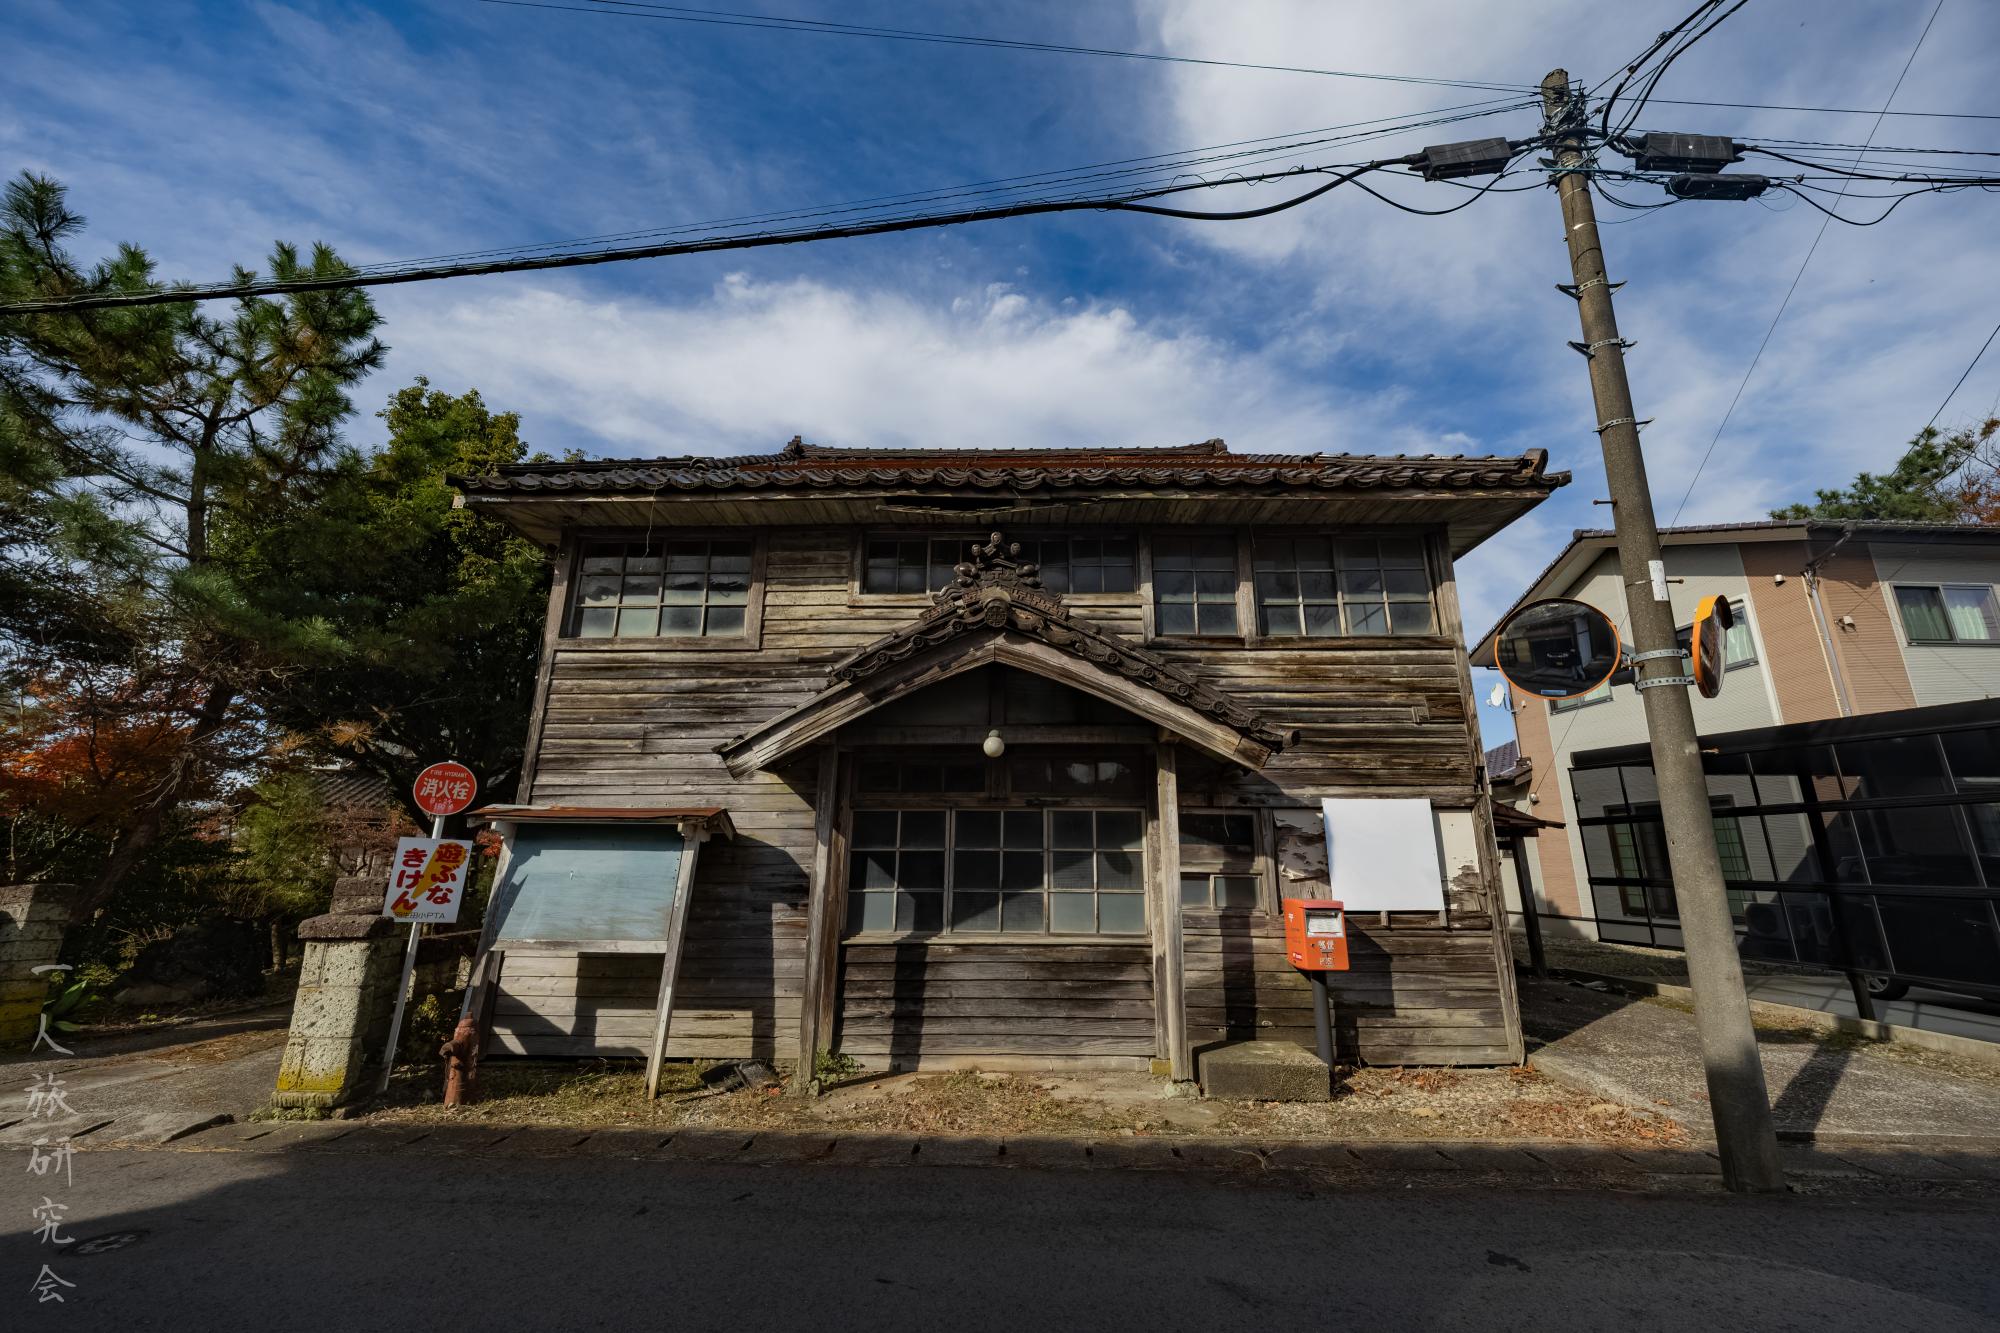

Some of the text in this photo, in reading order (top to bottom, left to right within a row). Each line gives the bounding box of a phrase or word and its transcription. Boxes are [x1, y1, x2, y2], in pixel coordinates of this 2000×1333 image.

[420, 777, 470, 800] 消火栓
[391, 848, 427, 913] きけん
[426, 843, 461, 905] 遊ぶな
